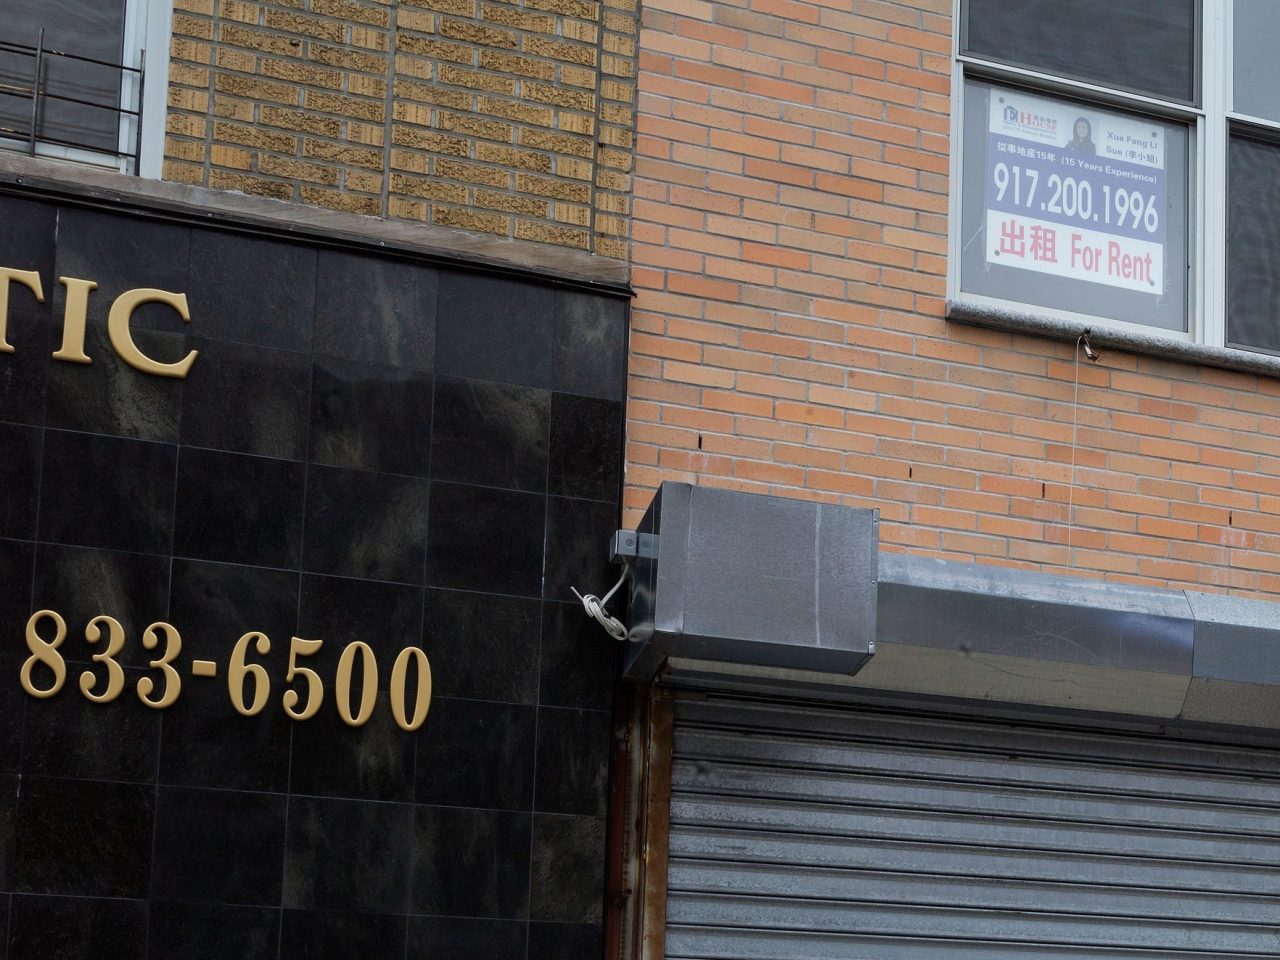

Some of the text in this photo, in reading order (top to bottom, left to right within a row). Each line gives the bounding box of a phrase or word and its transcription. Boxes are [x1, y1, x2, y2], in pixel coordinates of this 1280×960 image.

[1106, 145, 1123, 156] Sue
[1107, 131, 1124, 142] Xue
[1126, 136, 1148, 148] Fang
[1078, 159, 1103, 173] Years
[993, 162, 1159, 233] 917.200.1996
[1000, 219, 1153, 284] 出租 For Rent
[20, 609, 433, 732] 833-6500
